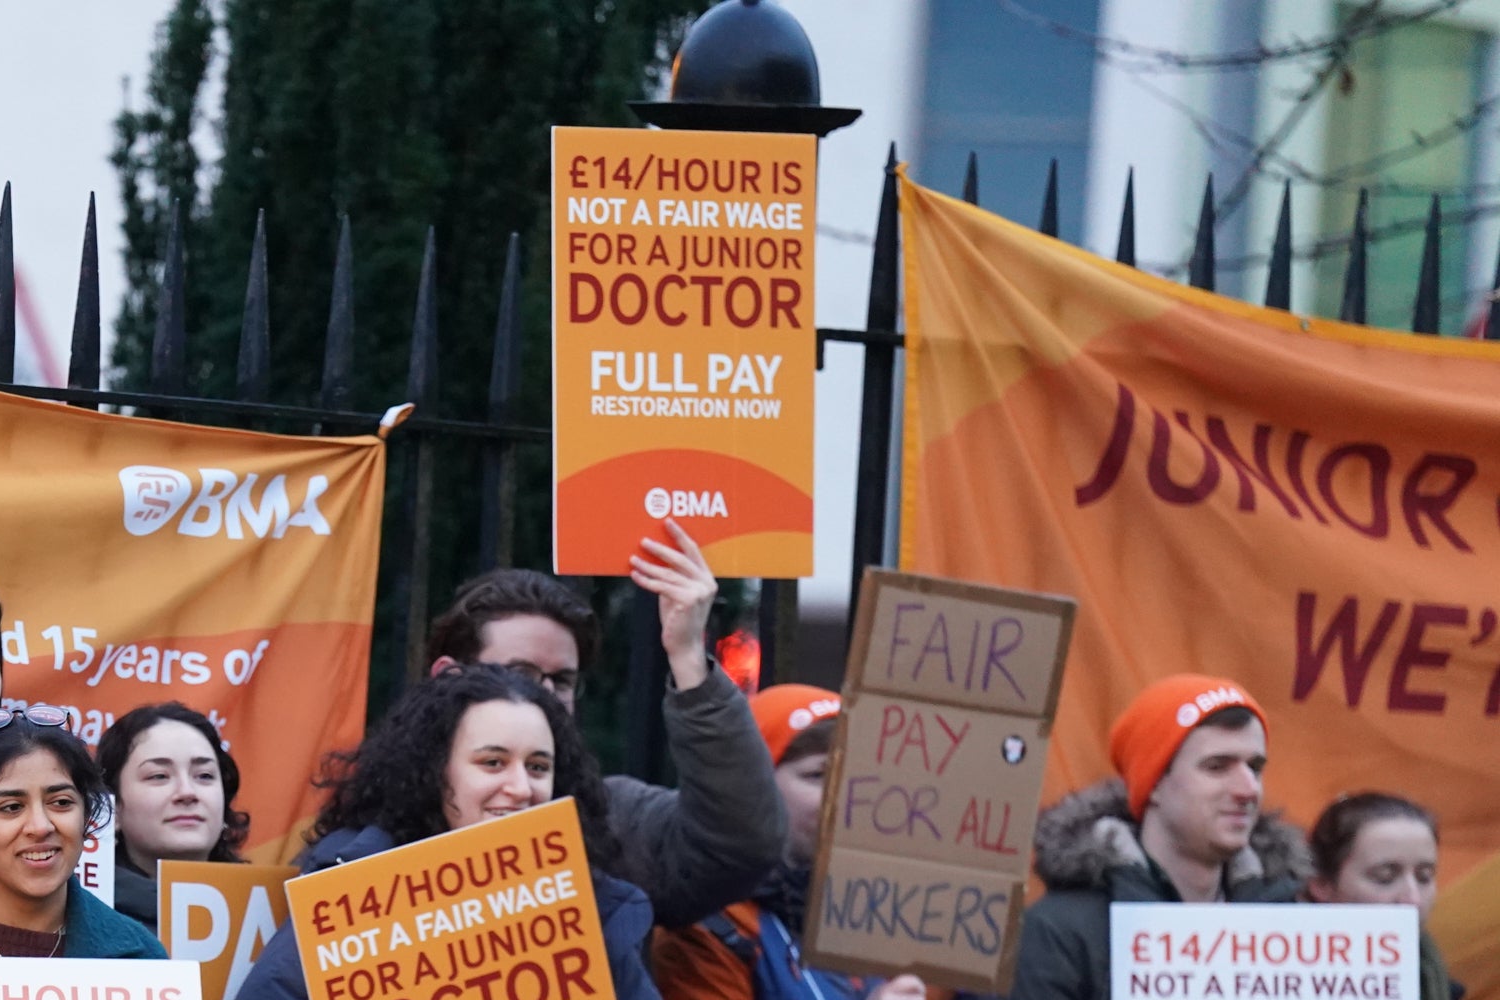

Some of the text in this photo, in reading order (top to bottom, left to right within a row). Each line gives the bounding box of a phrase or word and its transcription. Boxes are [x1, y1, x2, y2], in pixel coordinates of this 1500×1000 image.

[569, 154, 802, 195] £14/HOUR IS
[568, 197, 803, 230] NOT A FAIR WAGE
[569, 232, 802, 271] FOR A JUNIOR
[569, 272, 801, 329] DOCTOR
[591, 351, 782, 394] FULL PAY
[591, 395, 781, 419] RESTORATION NOW
[1075, 382, 1476, 554] JUNIOR
[179, 468, 331, 540] BMA
[672, 490, 728, 518] BMA
[42, 625, 97, 673] 15
[87, 644, 211, 687] years
[223, 639, 269, 685] of
[886, 604, 1026, 700] FAIR
[1292, 591, 1500, 717] WE'
[1195, 687, 1244, 713] BMA
[877, 705, 970, 776] PAY
[845, 777, 1018, 856] FOR ALL
[312, 830, 569, 936] £14/HOUR IS
[824, 872, 1006, 956] WORKERS
[317, 870, 578, 971] NOT A FAIR WAGE
[414, 952, 439, 985] A
[447, 906, 585, 981] JUNIOR
[1131, 930, 1401, 966] £14/HOUR IS
[1131, 973, 1401, 1000] NOT A FAIR WAGE
